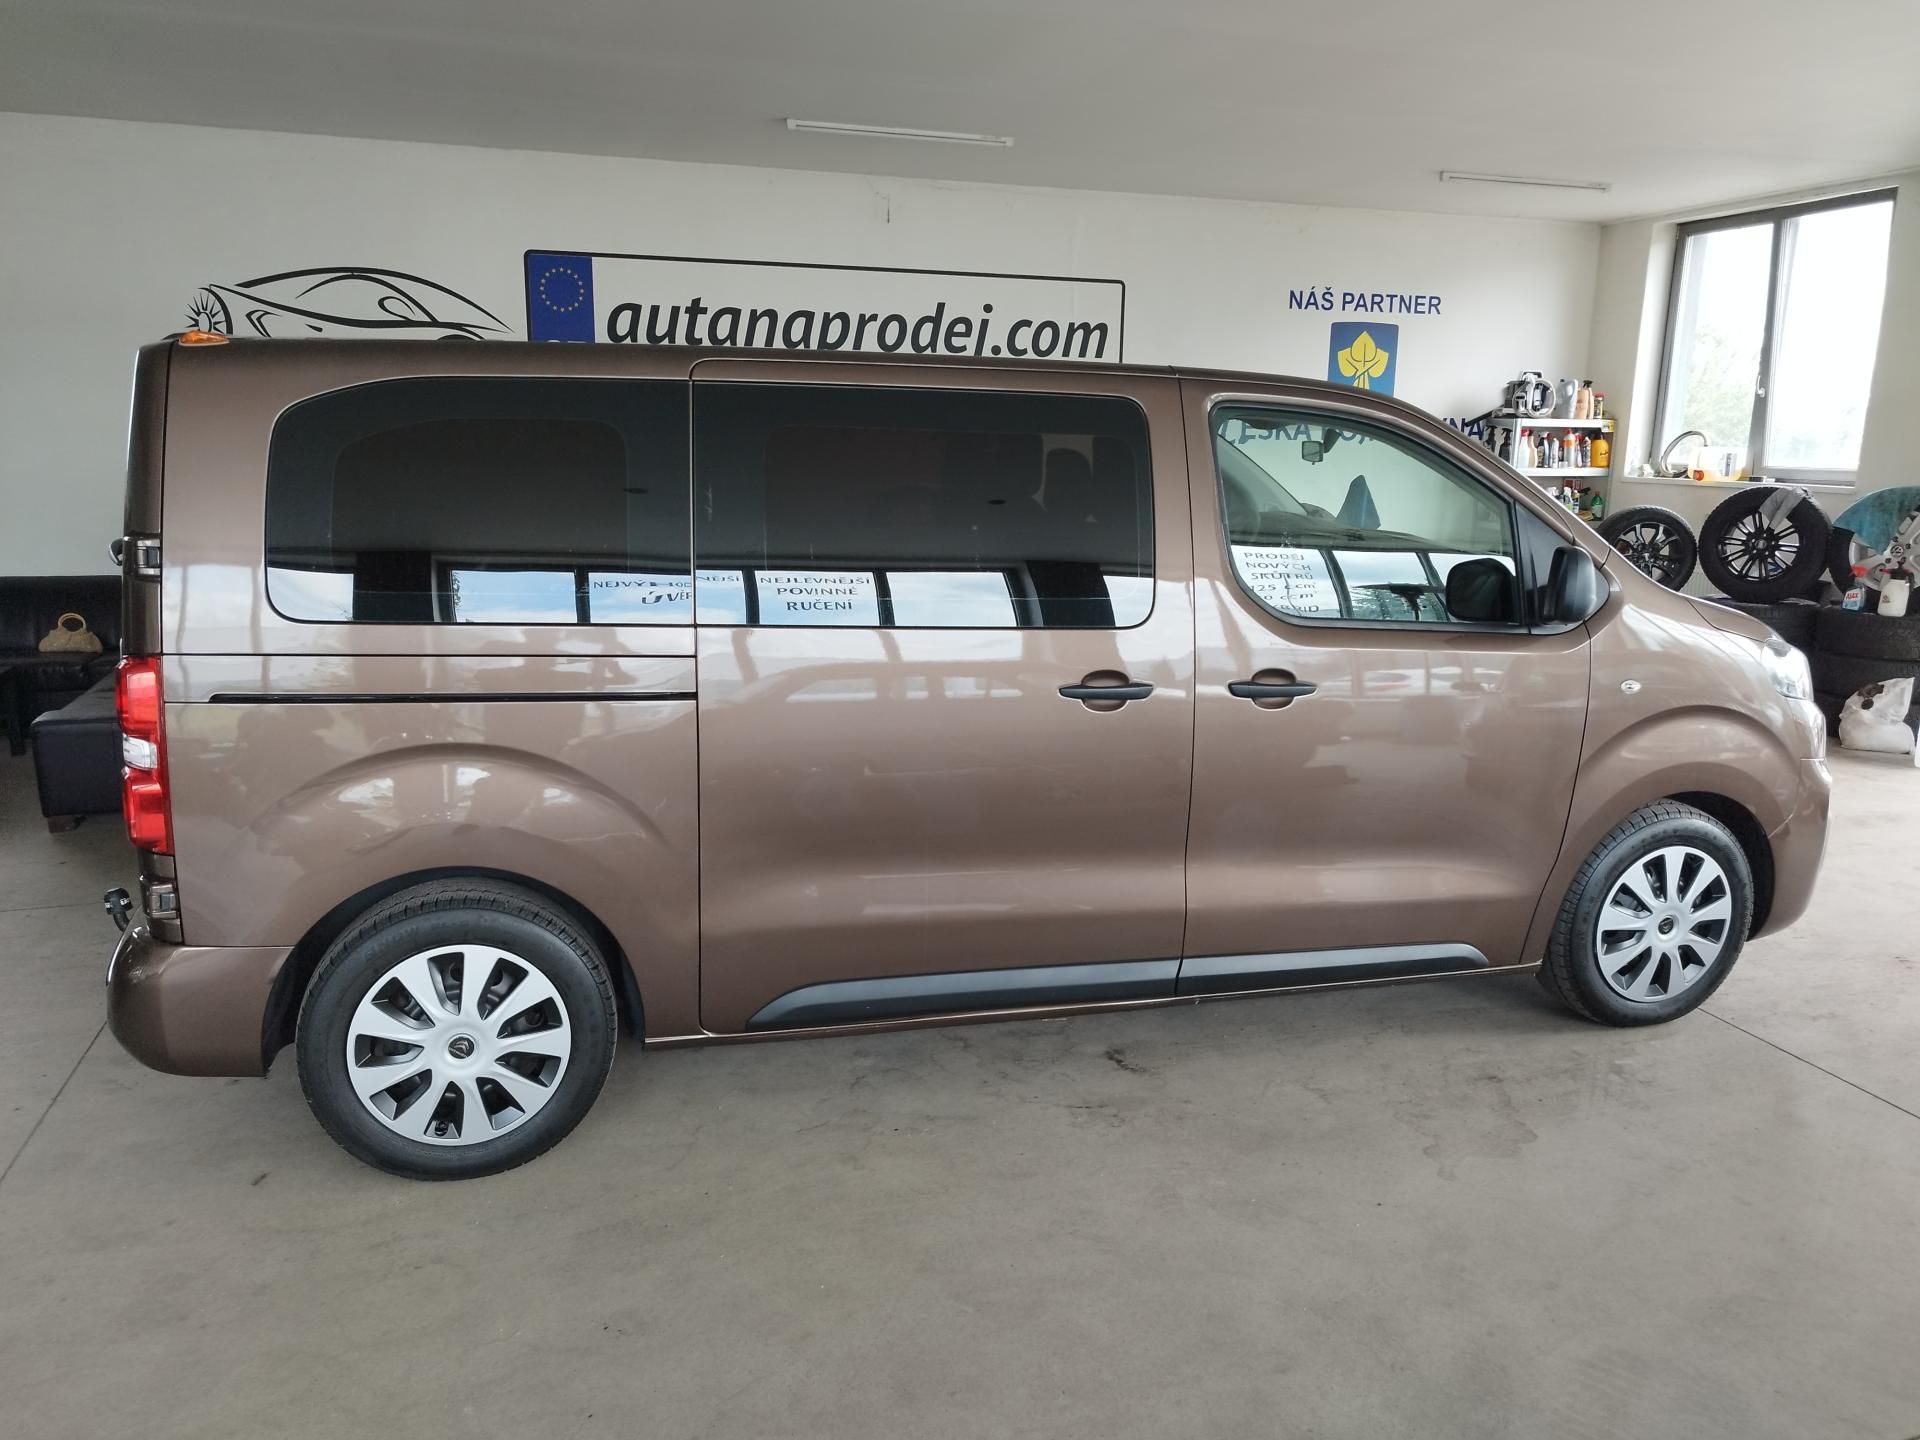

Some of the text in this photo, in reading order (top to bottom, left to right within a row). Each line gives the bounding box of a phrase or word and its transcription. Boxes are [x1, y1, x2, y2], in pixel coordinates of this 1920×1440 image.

[1288, 286, 1442, 315] NÁŠ PARTNER
[606, 296, 1109, 358] autanaprodej.com
[760, 576, 870, 585] NEJLEVNĚJŠÍ
[777, 587, 858, 595] POVINNÉ
[786, 598, 852, 611] RUČENÍ
